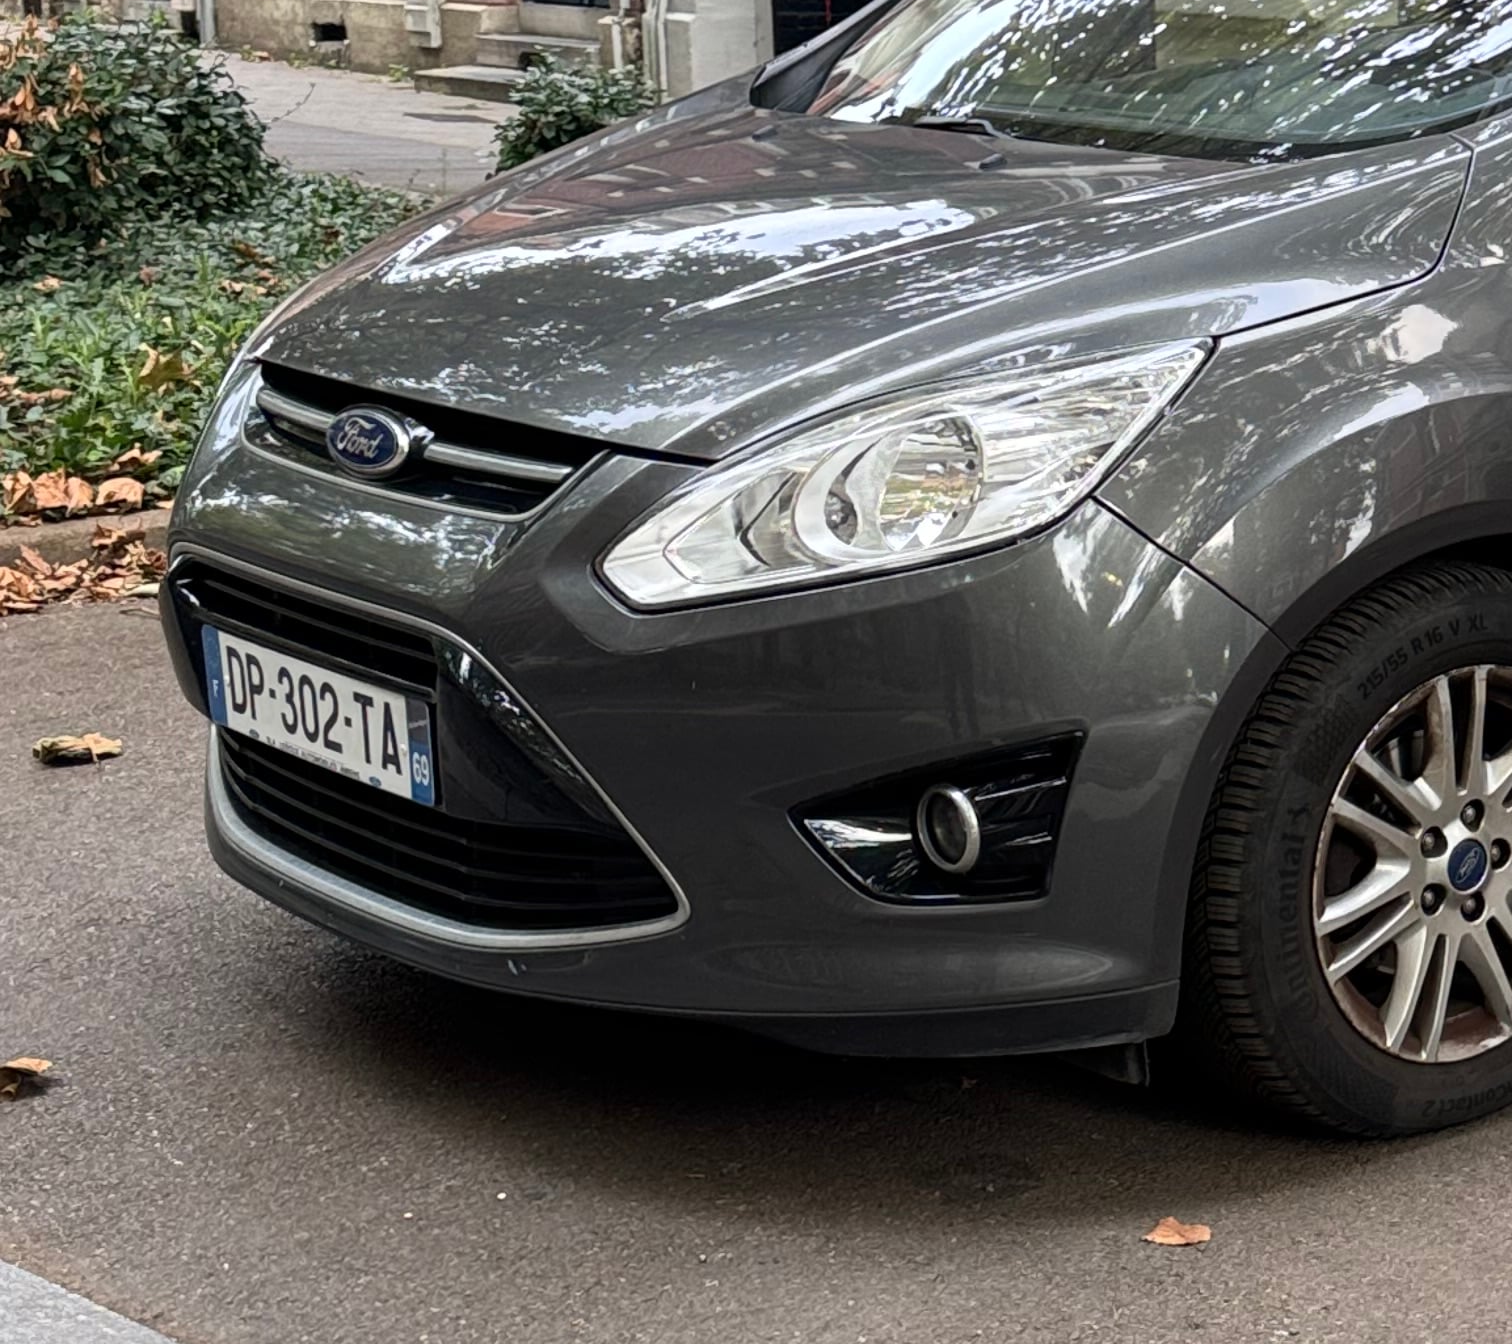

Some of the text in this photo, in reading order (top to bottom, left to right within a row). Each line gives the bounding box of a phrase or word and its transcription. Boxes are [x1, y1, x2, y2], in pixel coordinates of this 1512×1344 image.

[336, 416, 384, 460] Ford
[1356, 647, 1409, 701] 215/55
[1448, 618, 1461, 637] V
[1468, 611, 1489, 633] XL
[226, 645, 403, 776] DP-302-TA
[411, 752, 430, 787] 69
